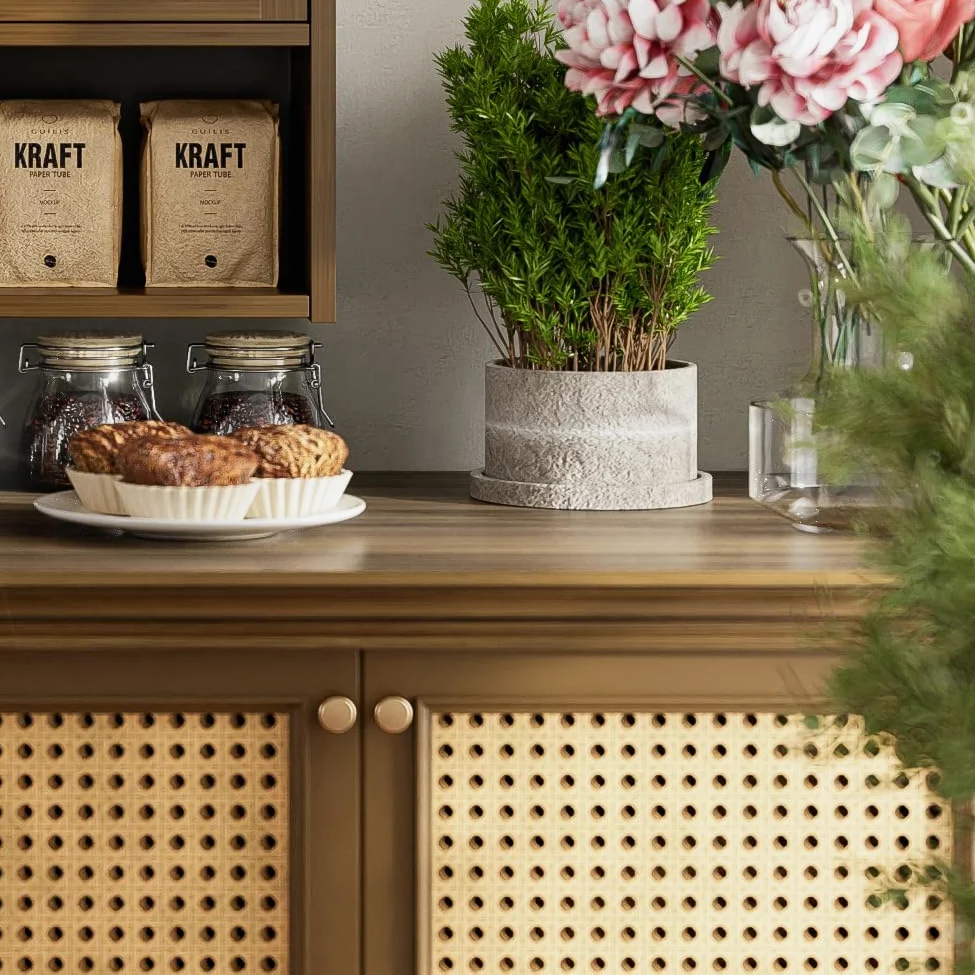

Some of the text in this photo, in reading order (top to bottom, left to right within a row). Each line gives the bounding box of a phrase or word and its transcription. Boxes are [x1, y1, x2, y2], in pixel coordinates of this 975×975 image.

[14, 142, 86, 169] KRAFT
[175, 142, 246, 169] KRAFT
[29, 170, 71, 178] PAPER TUBE
[190, 170, 232, 178] PAPER TUBE
